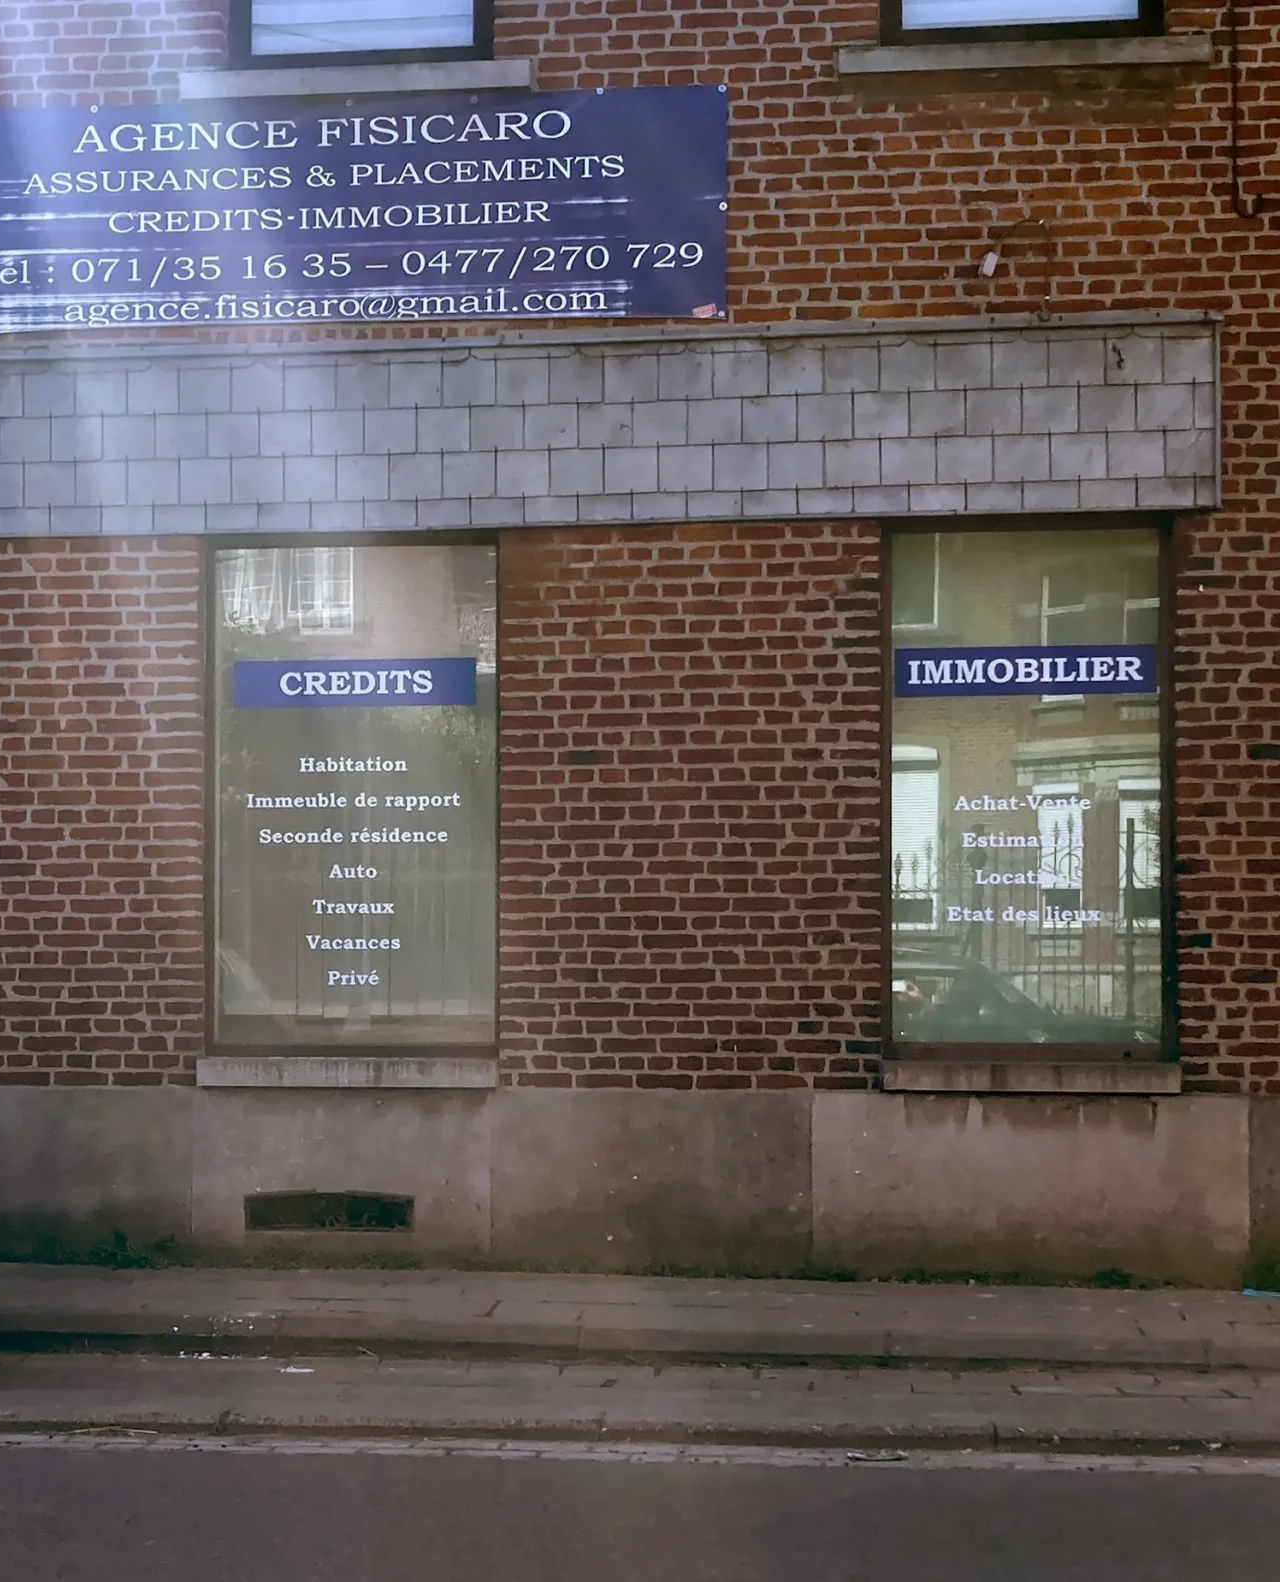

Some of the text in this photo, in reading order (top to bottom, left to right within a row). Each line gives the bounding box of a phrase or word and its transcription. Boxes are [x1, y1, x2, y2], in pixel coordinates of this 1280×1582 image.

[73, 109, 572, 154] AGENCE FISICARO
[22, 154, 626, 196] ASSURANCES & PLACEMENTS
[107, 199, 552, 234] CREDITS-IMMOBILIER
[46, 264, 56, 284] :
[70, 255, 222, 289] 071/35
[241, 253, 288, 280] 16
[301, 251, 353, 279] 35
[400, 243, 611, 280] 0477/270
[625, 241, 705, 270] 729
[63, 286, 609, 327] agence.fisicaro@gmail.com
[907, 655, 1145, 686] IMMOBILIER
[278, 669, 434, 697] CREDITS
[298, 756, 409, 774] Habitation
[246, 792, 462, 812] Immeuble de rapport
[954, 794, 1092, 812] Achat-Vente
[258, 826, 449, 845] Seconde résidence
[328, 863, 378, 880] Auto
[311, 898, 396, 915] Travaux
[946, 905, 1102, 923] Etat des lieux
[305, 934, 402, 951] Vacances
[326, 969, 381, 987] Privé
